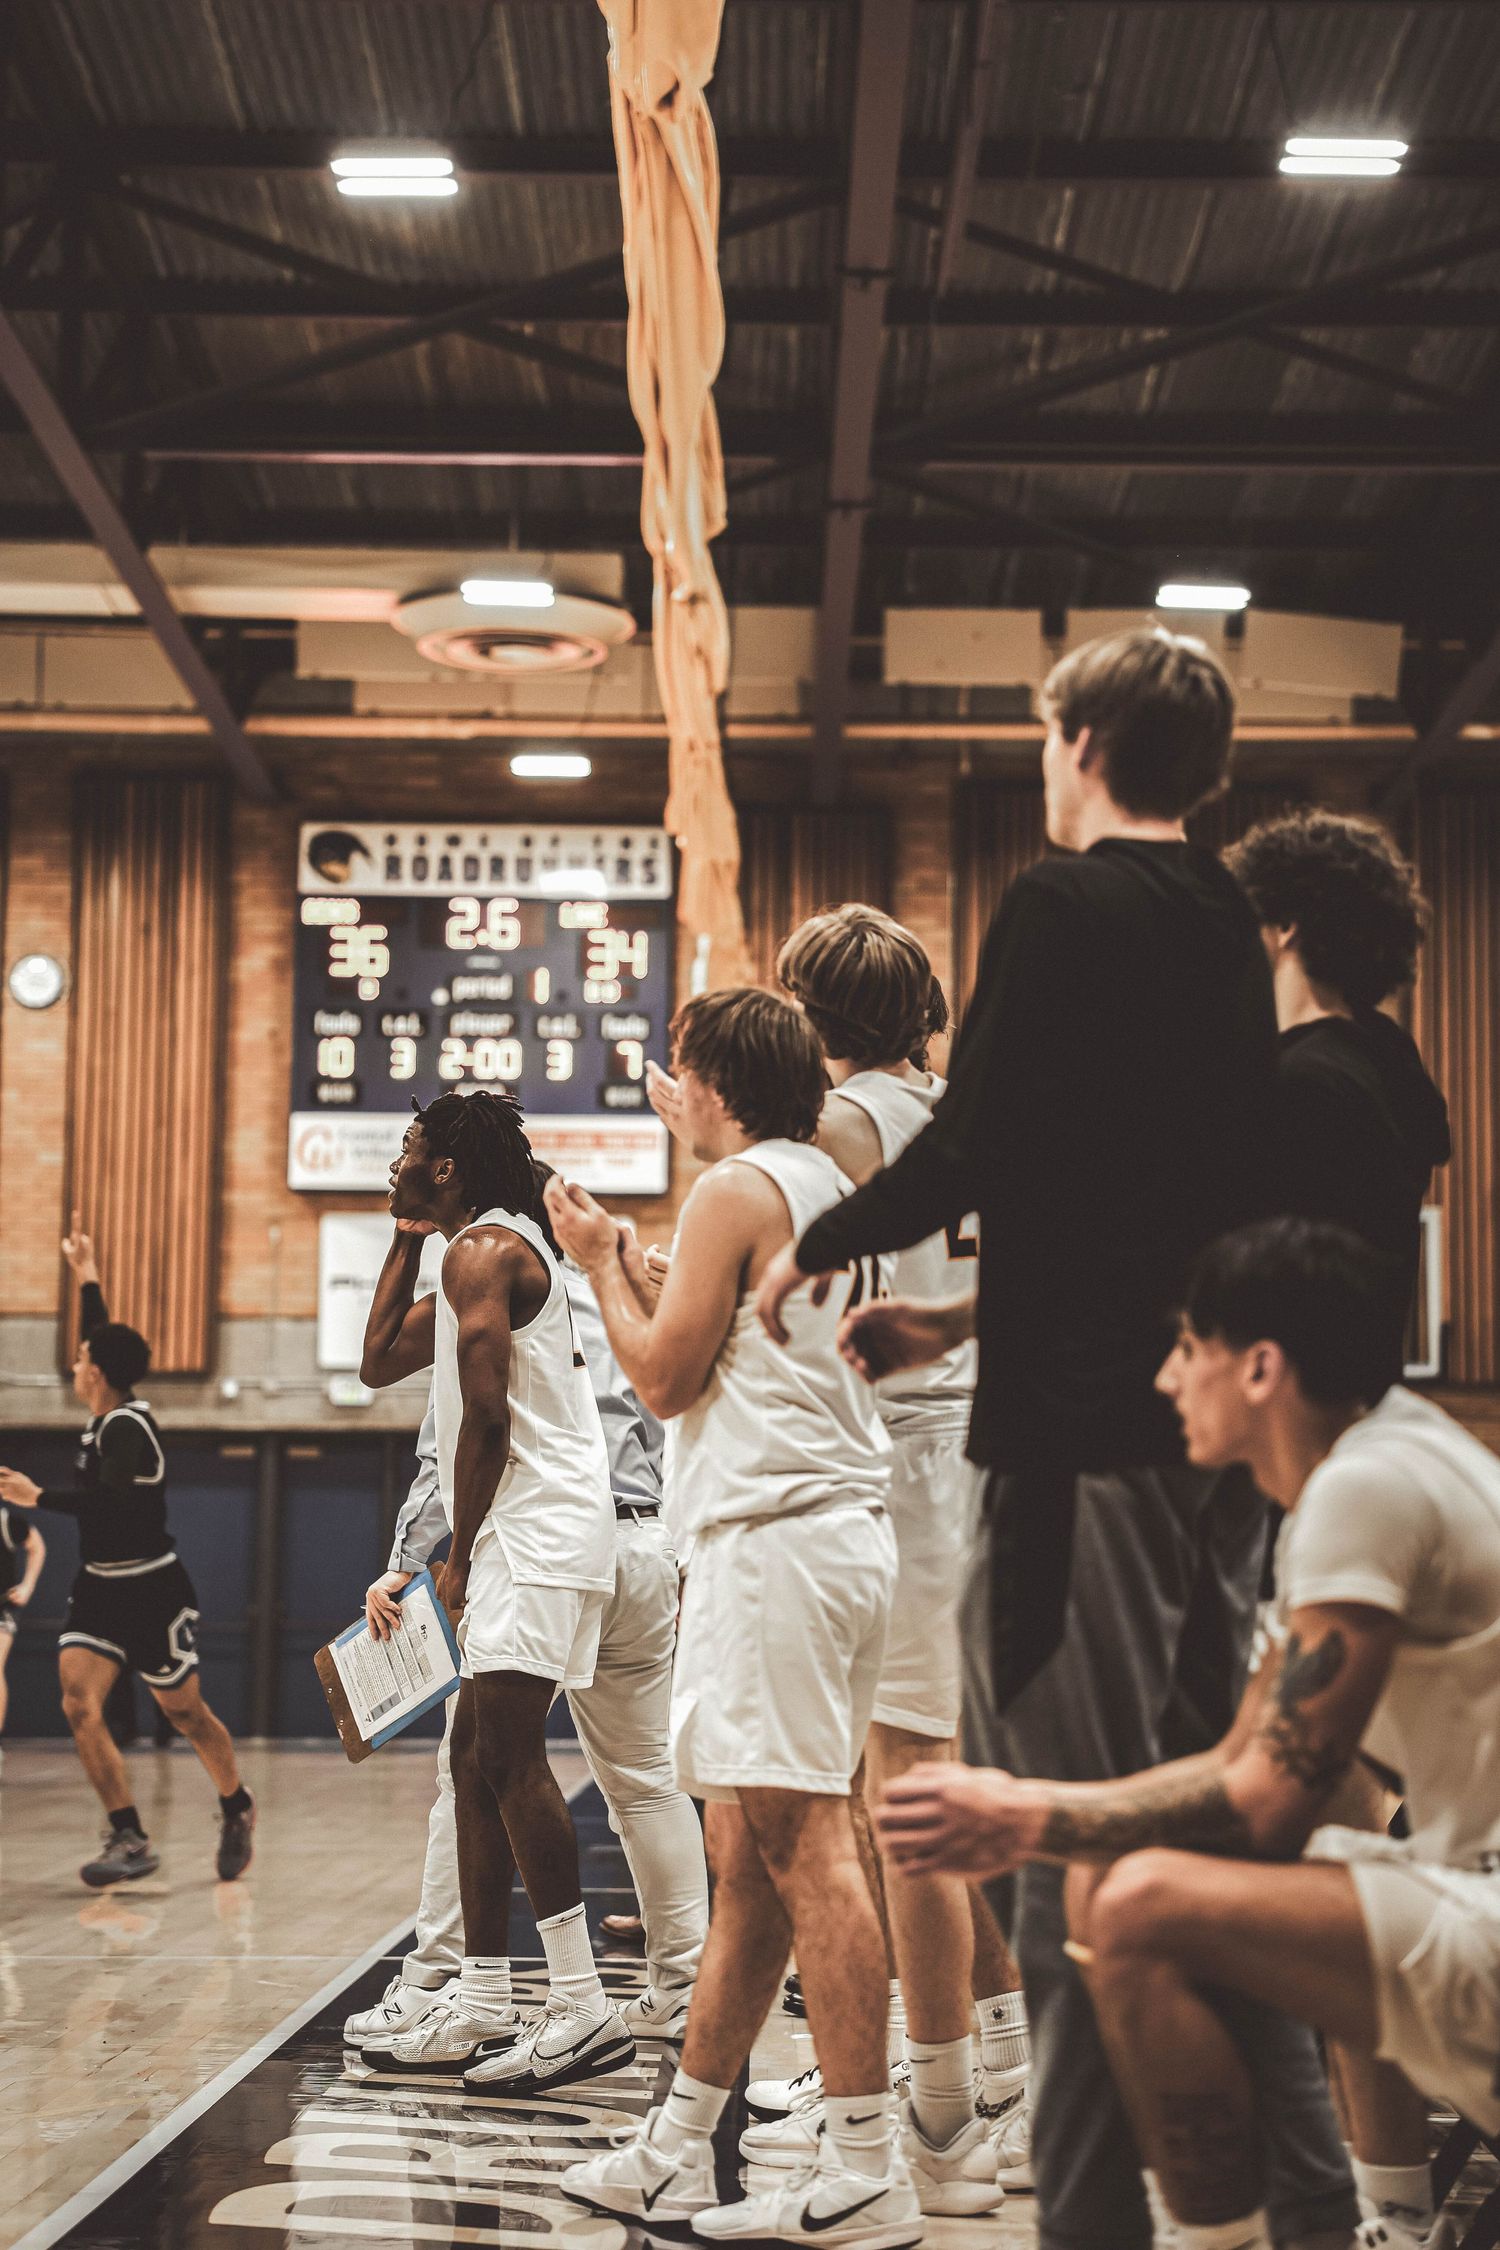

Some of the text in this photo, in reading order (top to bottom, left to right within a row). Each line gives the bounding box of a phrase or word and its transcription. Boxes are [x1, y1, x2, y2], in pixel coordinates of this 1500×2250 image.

[446, 897, 521, 950] 2.6
[329, 924, 390, 978] 36
[587, 928, 649, 980] 34
[317, 1036, 355, 1078] 10
[389, 1036, 416, 1080] 3
[546, 1038, 573, 1081] 3
[616, 1040, 643, 1080] 7
[381, 2000, 406, 2025] N
